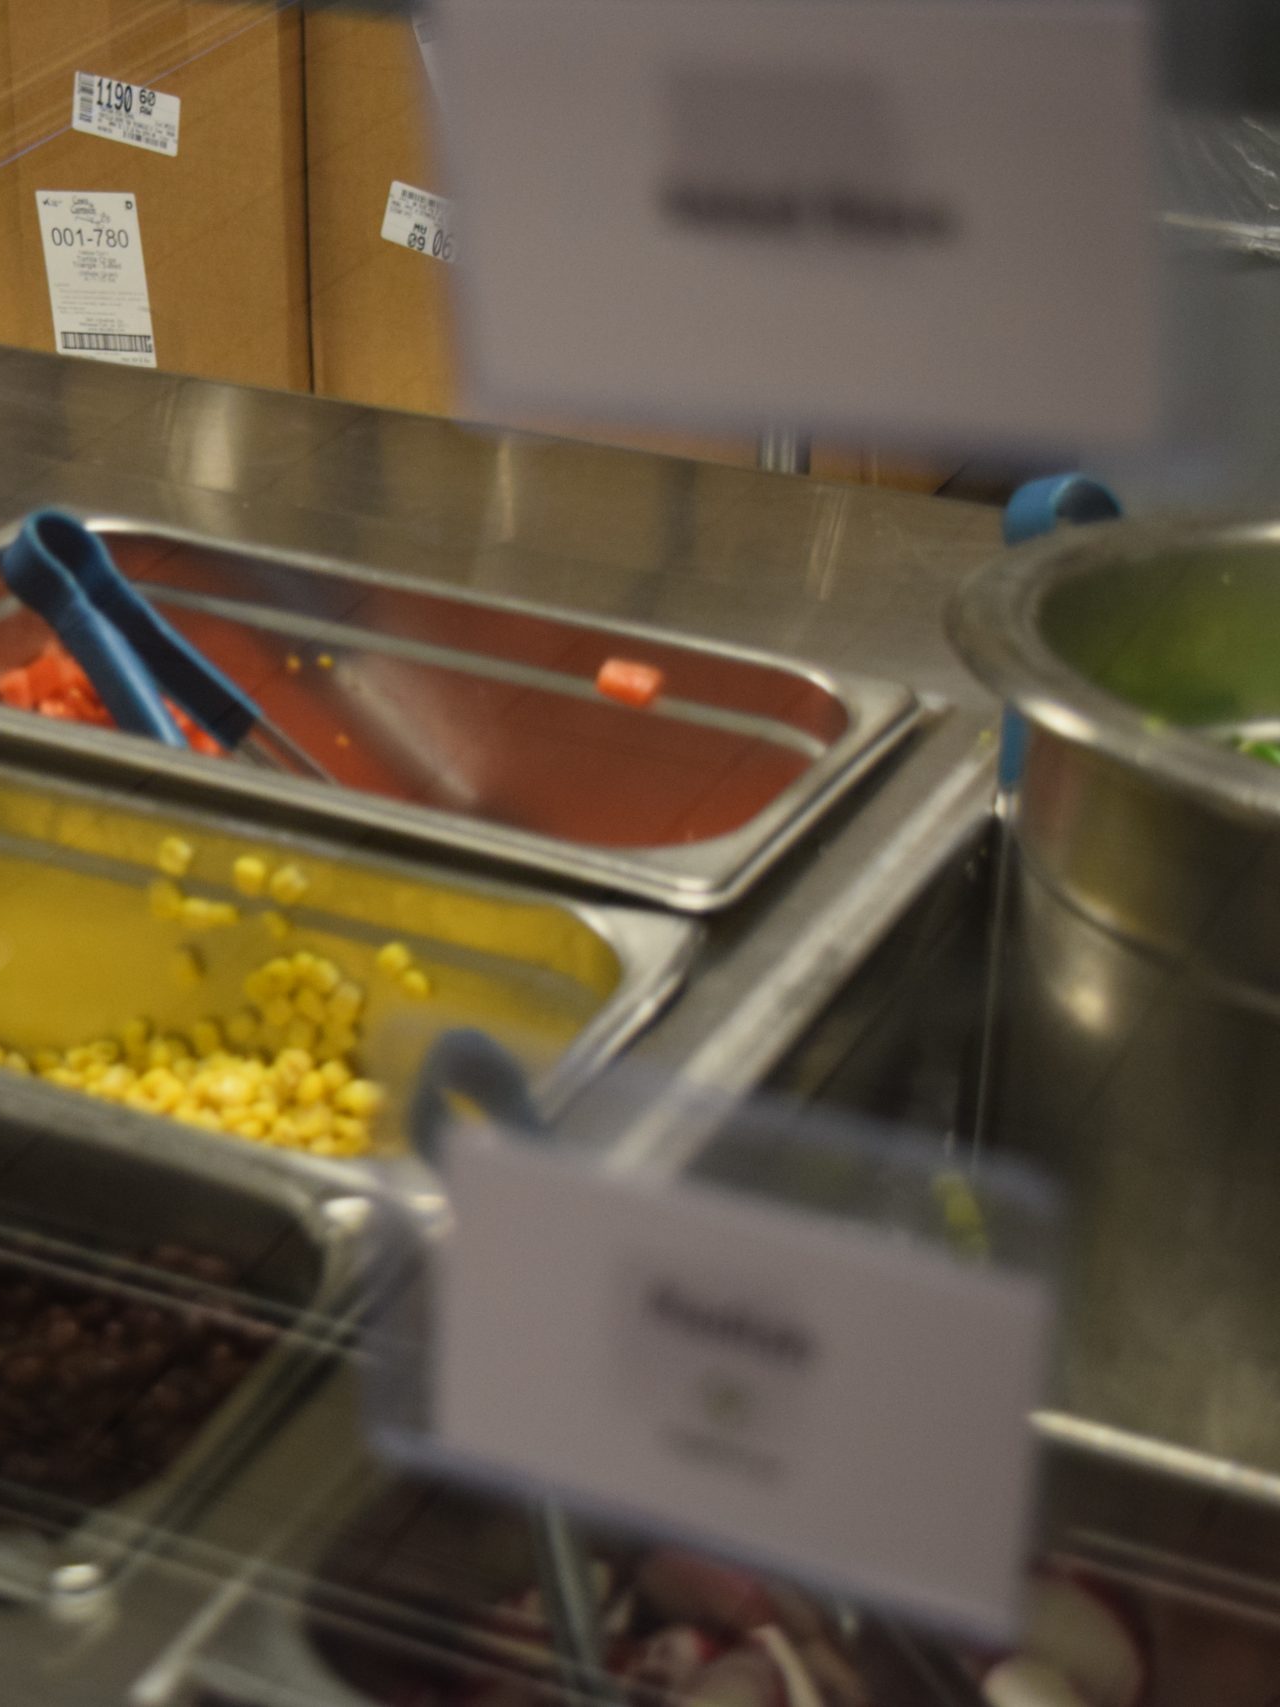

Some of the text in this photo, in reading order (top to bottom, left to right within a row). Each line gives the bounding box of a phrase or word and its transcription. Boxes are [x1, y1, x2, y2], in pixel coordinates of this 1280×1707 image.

[96, 78, 156, 113] 1190 60
[51, 227, 129, 249] 001-780
